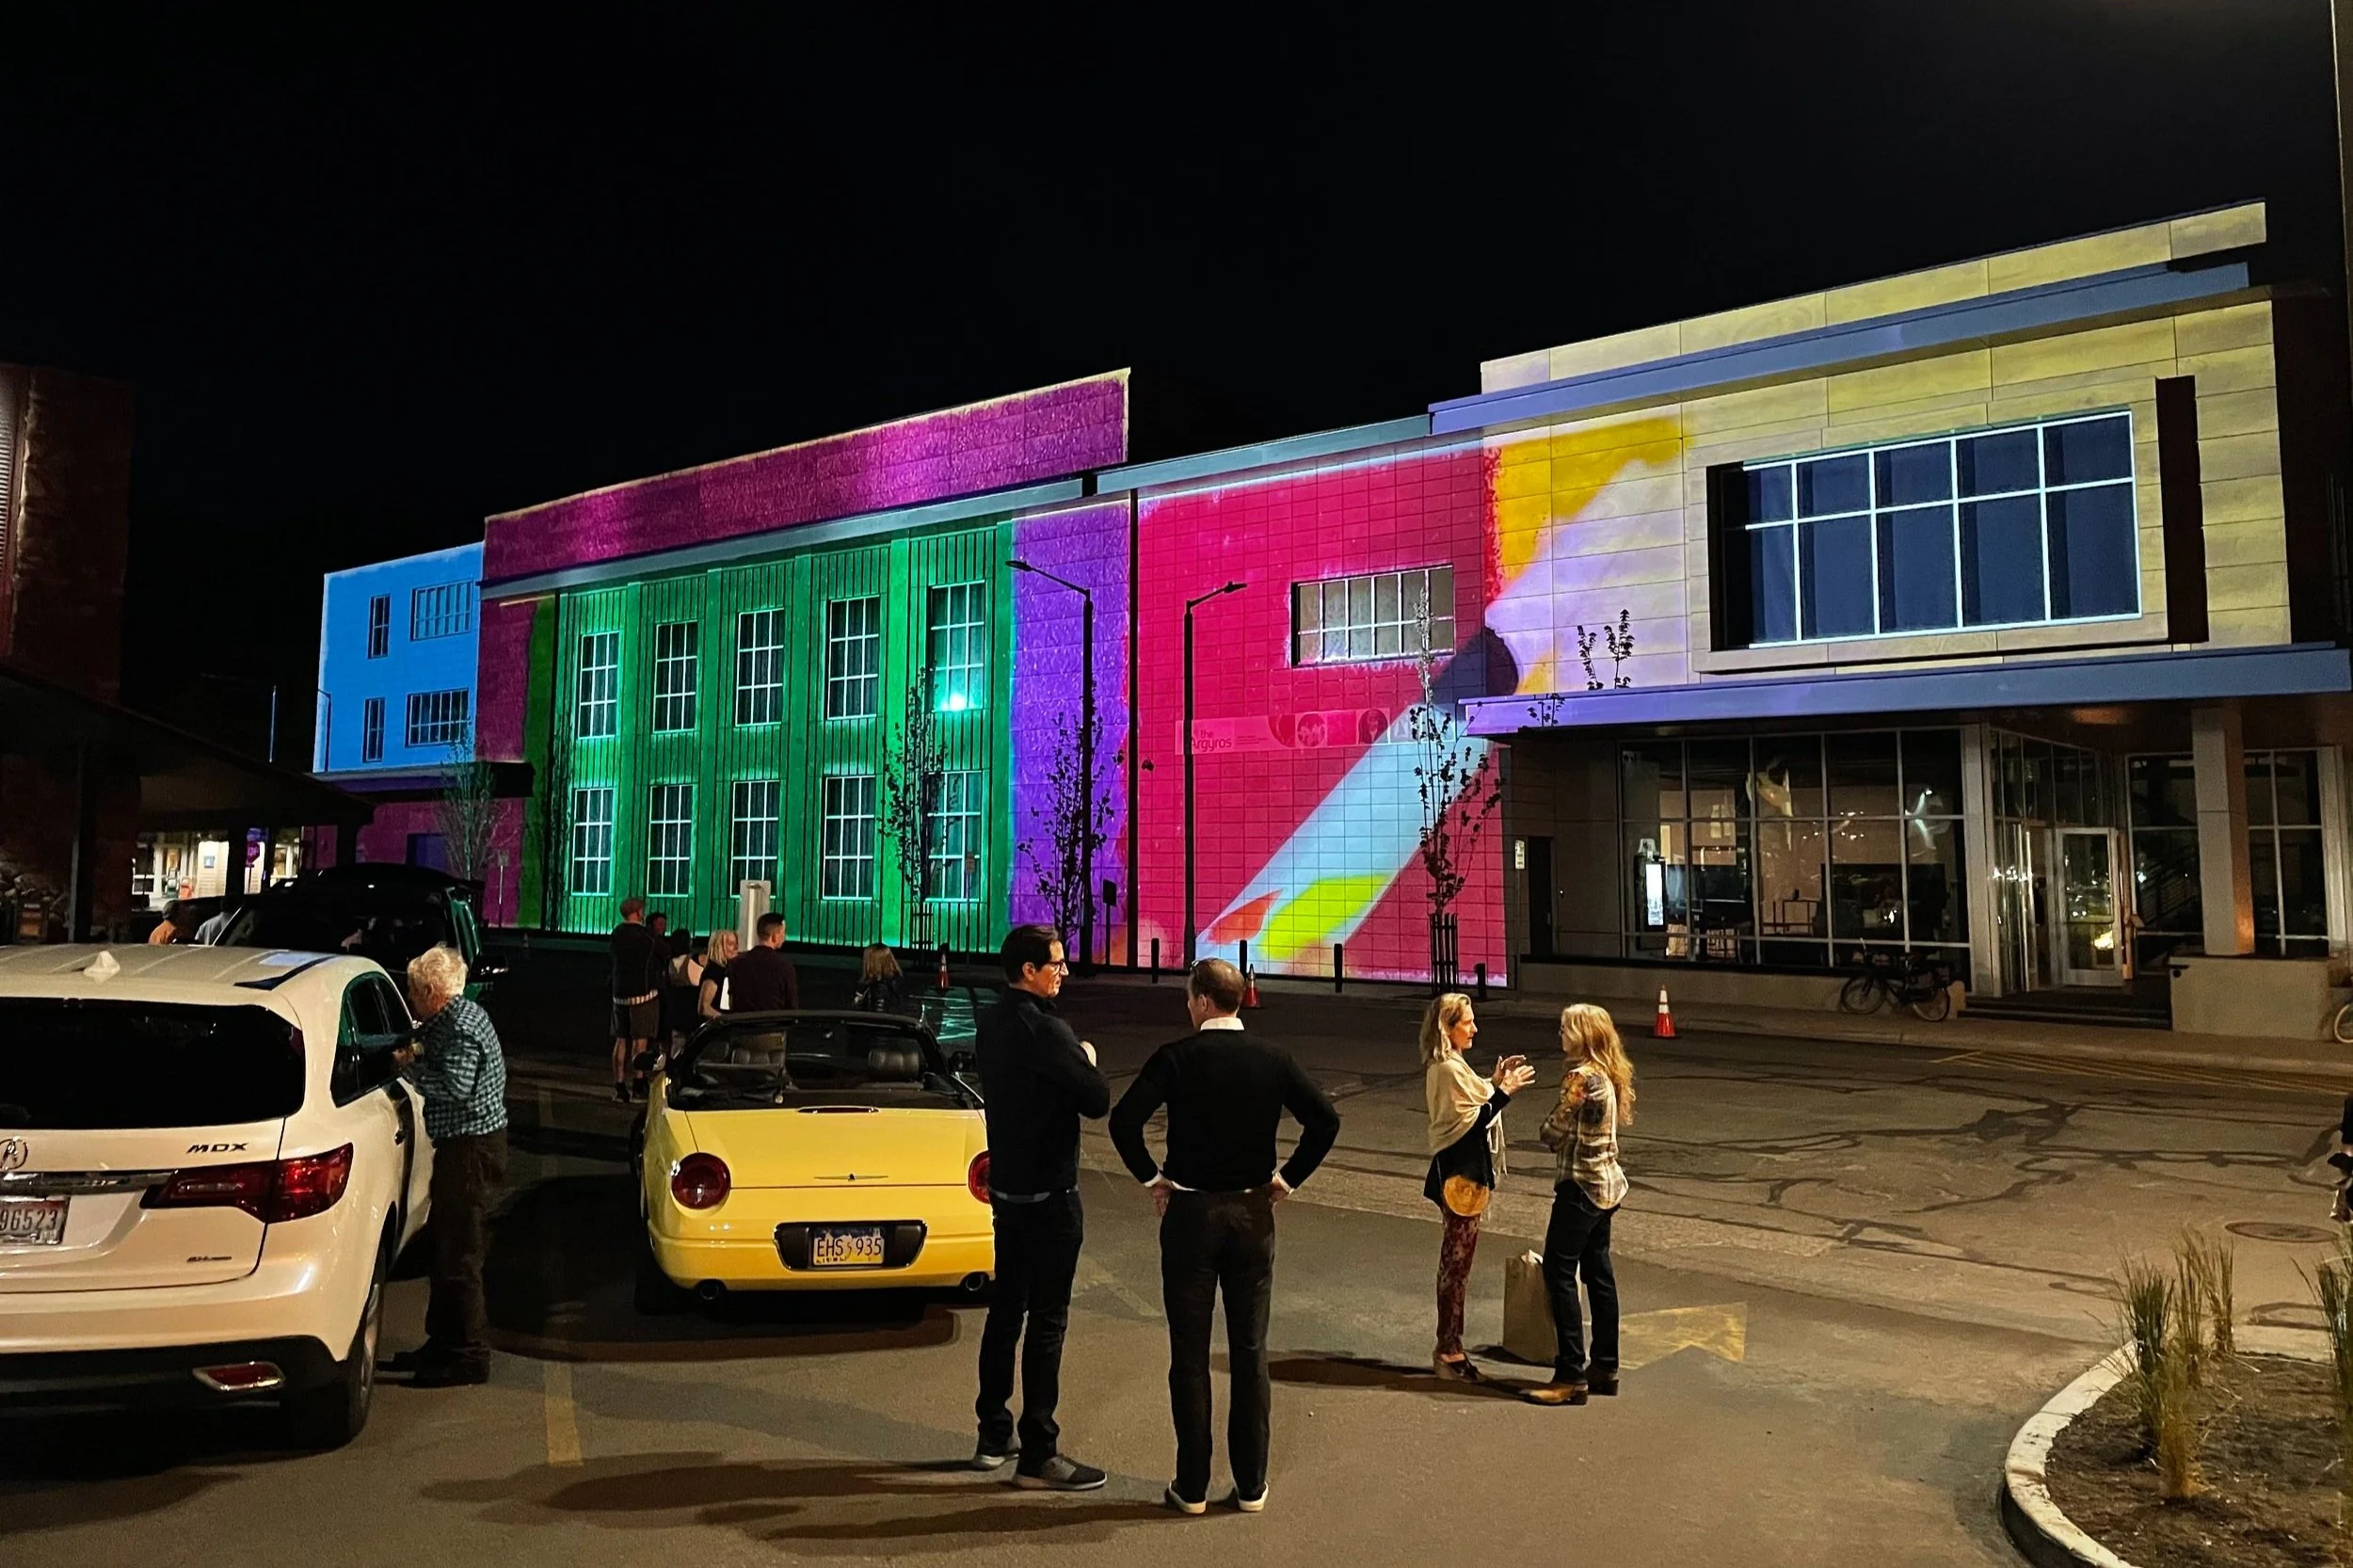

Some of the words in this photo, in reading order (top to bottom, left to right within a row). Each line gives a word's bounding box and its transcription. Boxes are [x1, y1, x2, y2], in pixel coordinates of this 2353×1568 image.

[1200, 729, 1213, 739] the
[185, 1143, 248, 1154] MDX
[817, 1238, 844, 1257] EHS
[856, 1237, 882, 1256] 935
